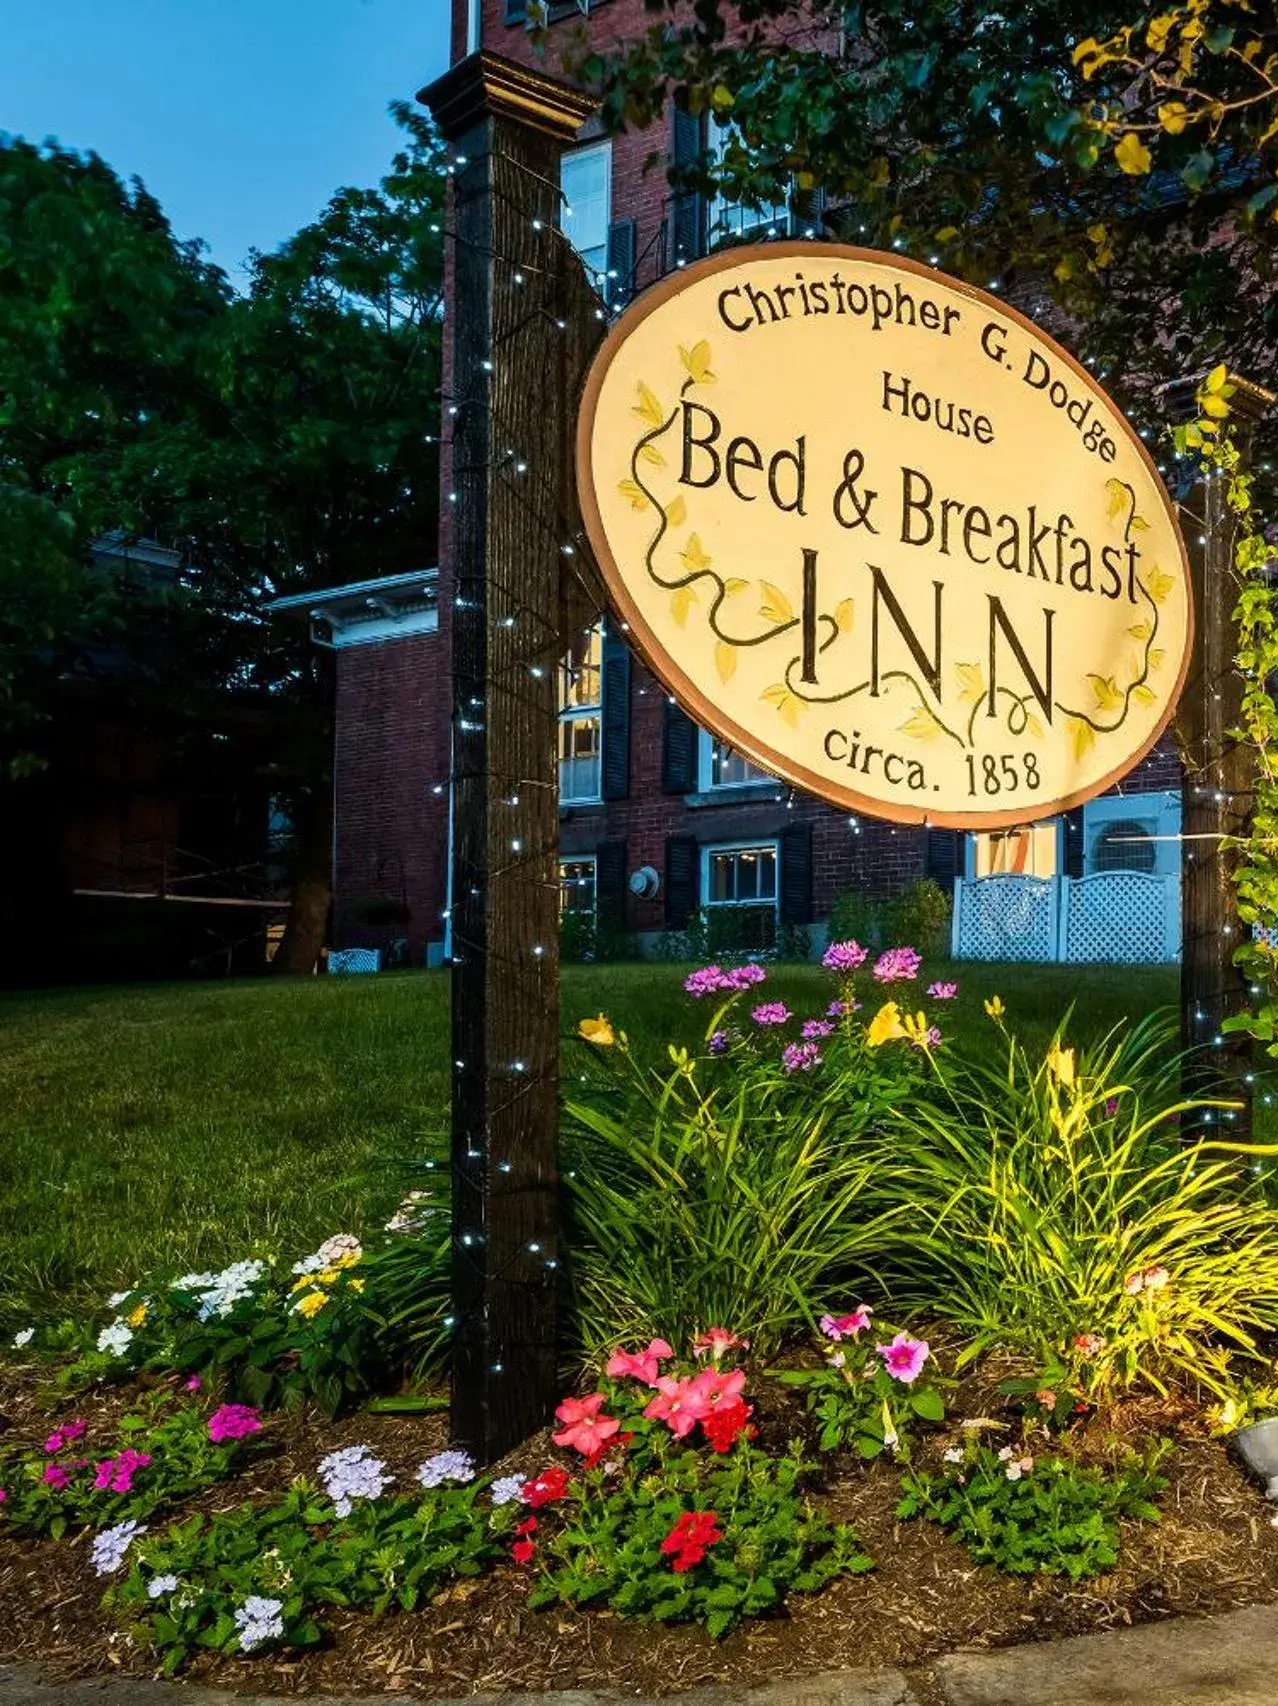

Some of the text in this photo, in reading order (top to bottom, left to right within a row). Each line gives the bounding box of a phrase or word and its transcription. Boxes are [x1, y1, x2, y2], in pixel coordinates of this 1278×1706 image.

[717, 272, 1119, 464] Christopher G. Dodge
[881, 370, 996, 446] House
[676, 399, 1143, 606] Bed & Breakfast
[800, 547, 1056, 727] INN
[965, 753, 1042, 797] 1858
